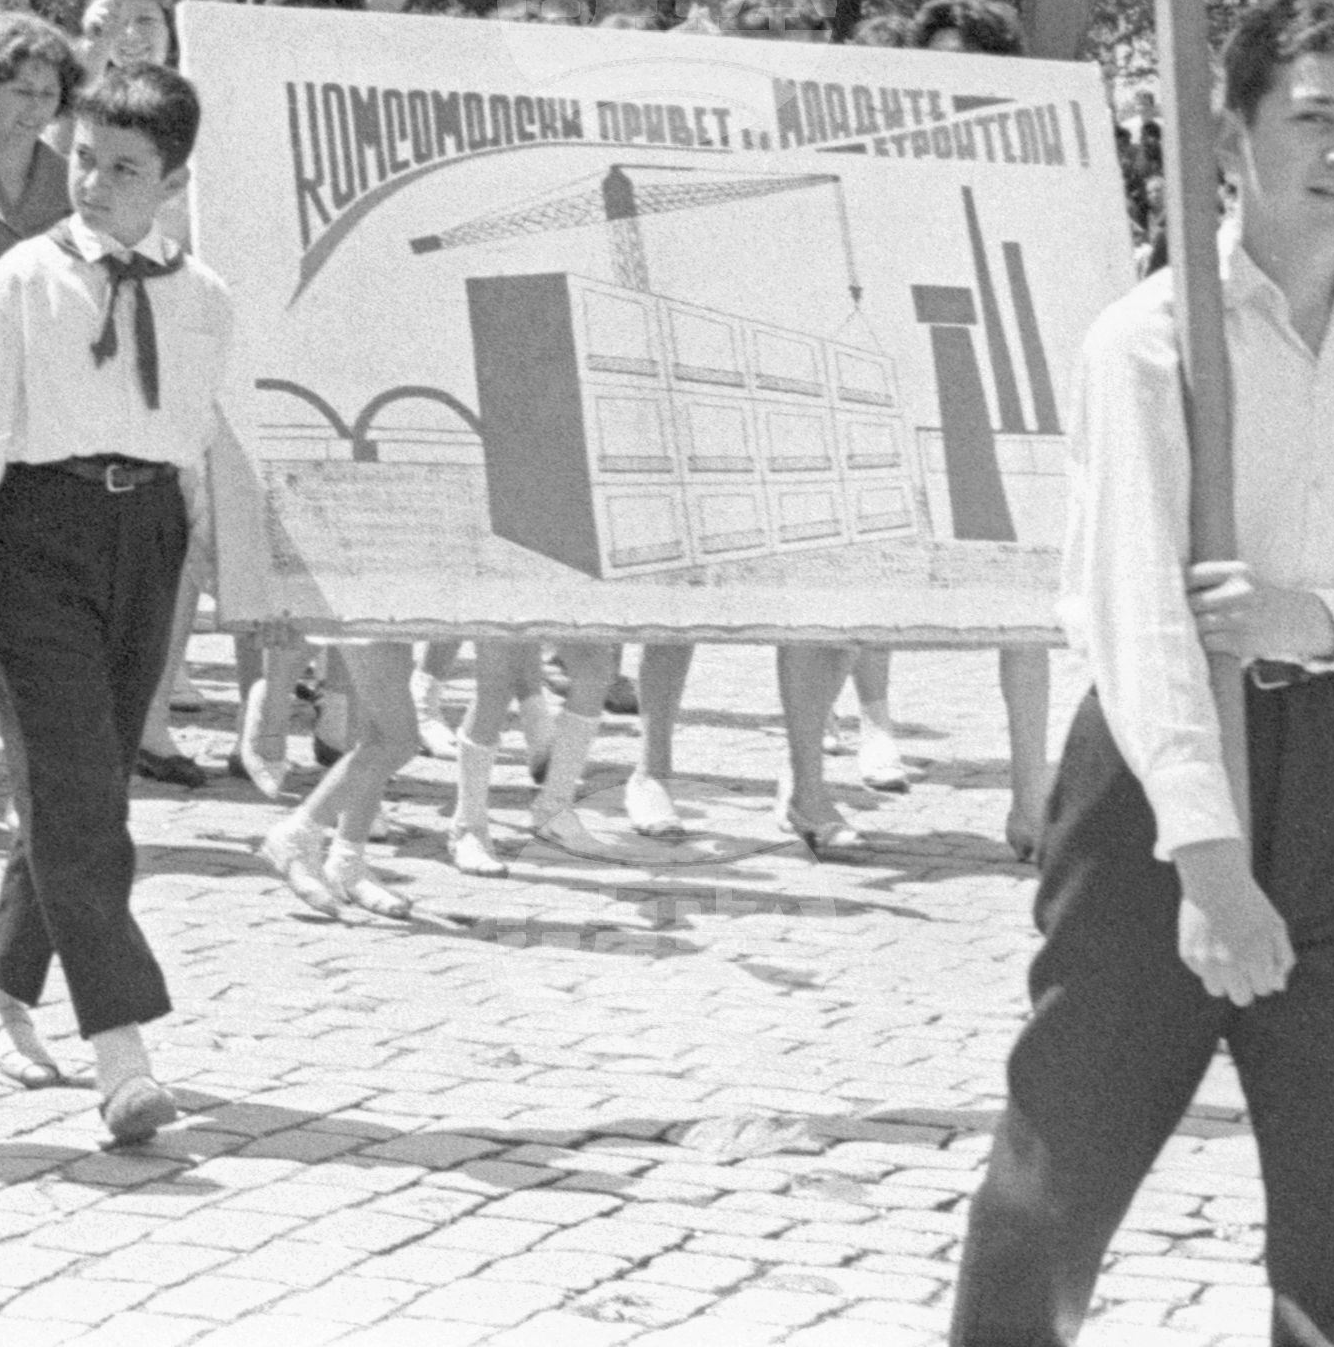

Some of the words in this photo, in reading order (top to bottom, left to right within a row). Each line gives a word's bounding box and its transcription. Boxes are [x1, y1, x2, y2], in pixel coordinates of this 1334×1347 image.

[286, 81, 584, 249] КОМСОМОЛСКИ
[596, 99, 732, 148] ПРИВЕТ
[772, 77, 946, 150] МЛАДИТЕ
